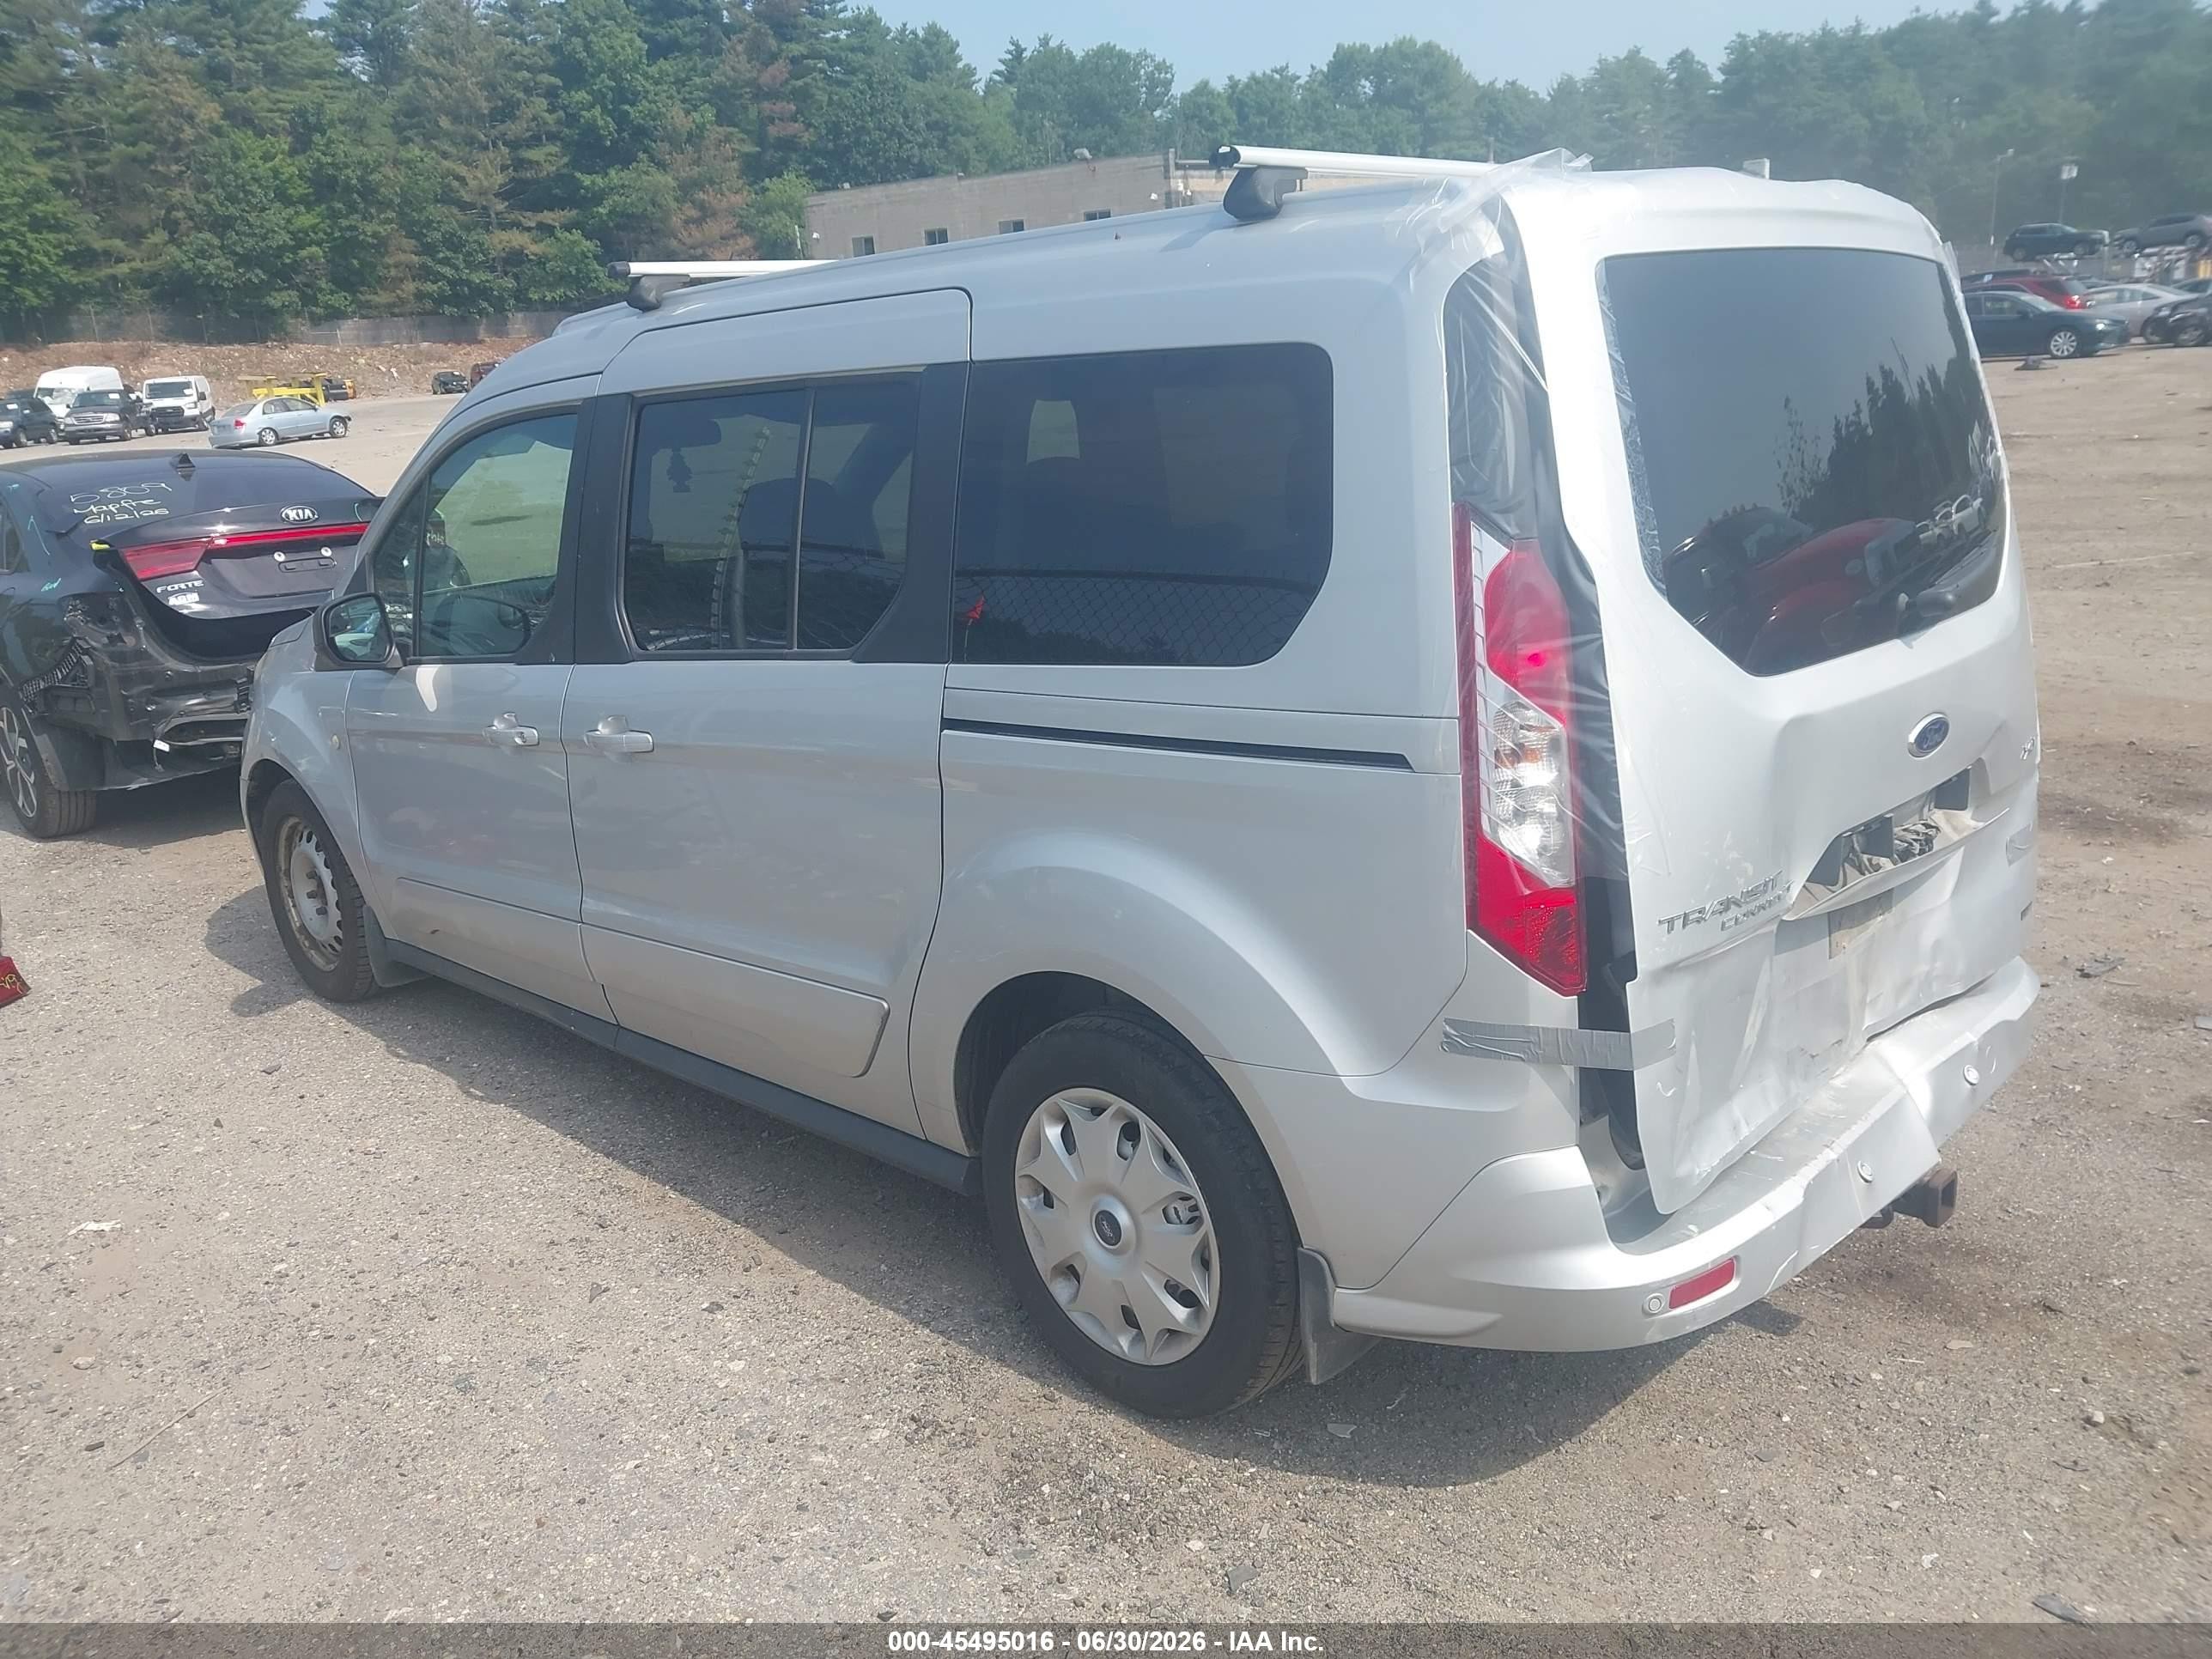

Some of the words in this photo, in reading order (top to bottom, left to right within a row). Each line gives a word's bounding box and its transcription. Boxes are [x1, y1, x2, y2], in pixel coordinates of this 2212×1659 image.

[70, 483, 173, 505] 5809
[156, 580, 205, 593] FORTE
[1656, 870, 1783, 934] TRANSIT
